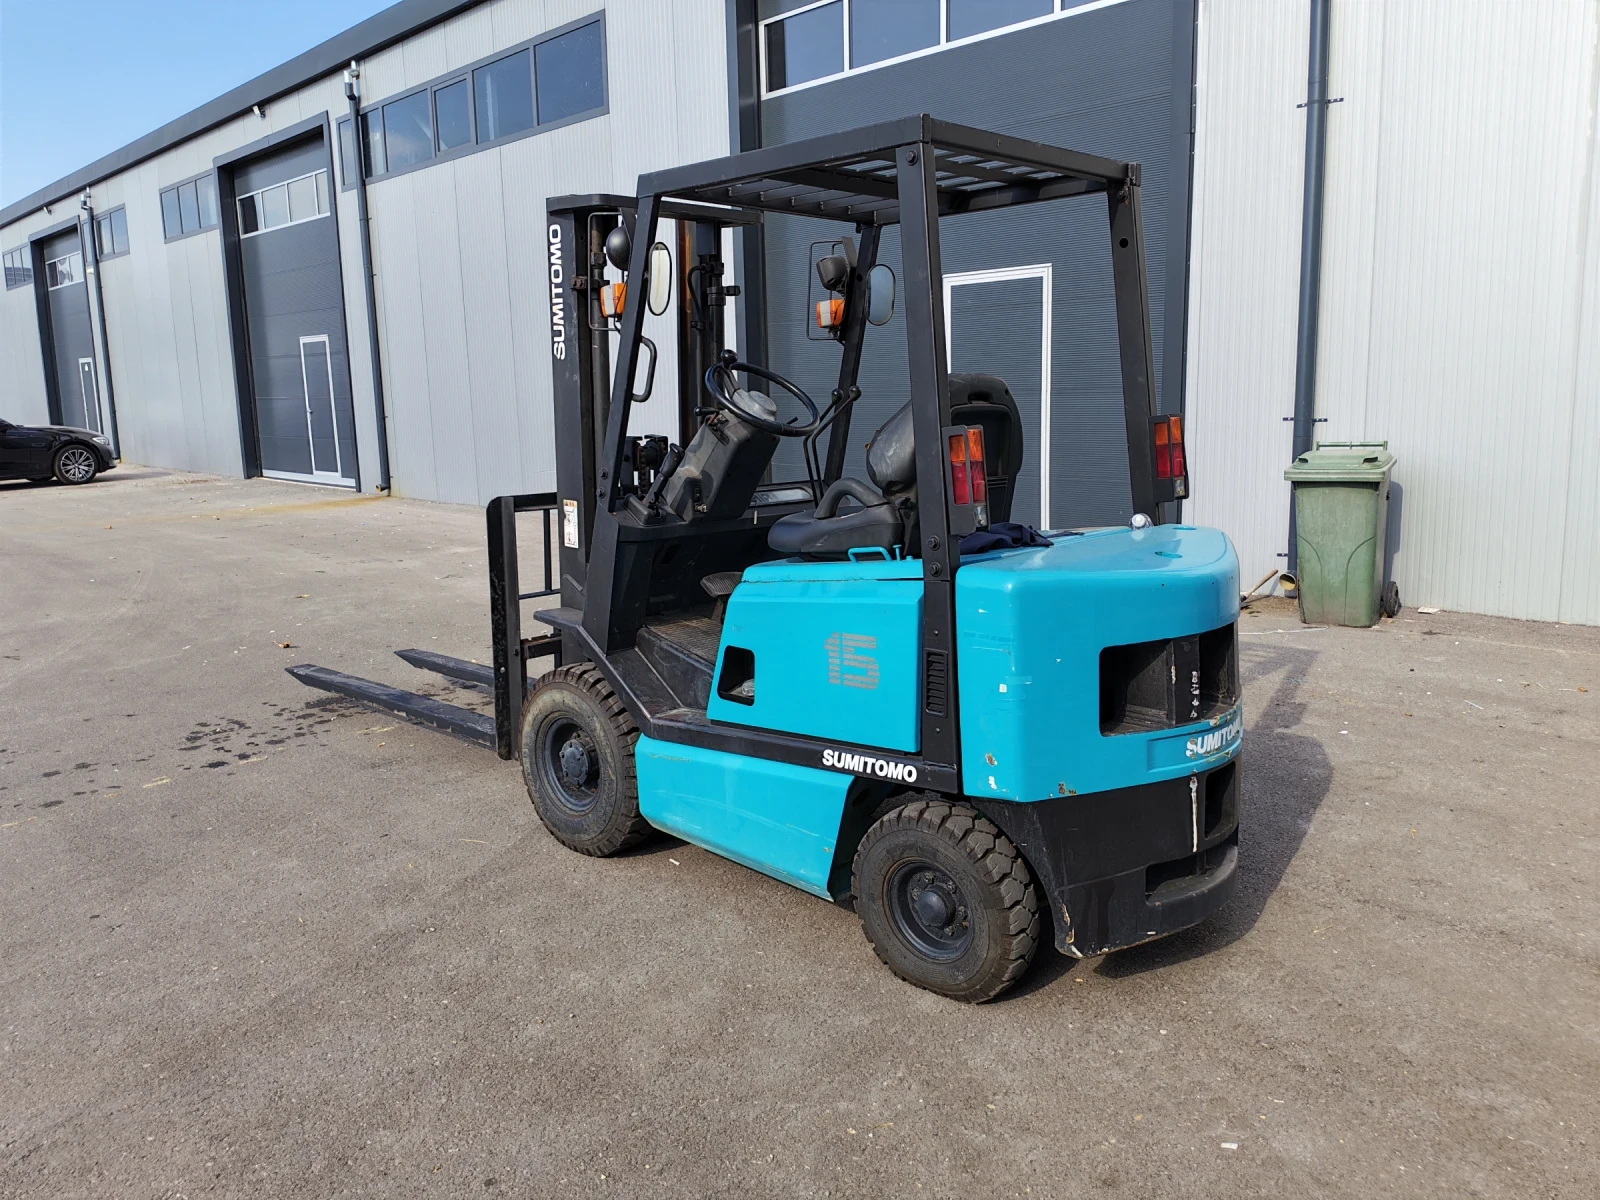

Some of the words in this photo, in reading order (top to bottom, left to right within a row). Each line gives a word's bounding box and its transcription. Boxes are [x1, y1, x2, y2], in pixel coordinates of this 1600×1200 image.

[549, 223, 566, 360] SUMITOMO
[824, 631, 879, 690] 15
[1186, 715, 1241, 759] SUMITOM
[822, 749, 918, 783] SUMITOMO
